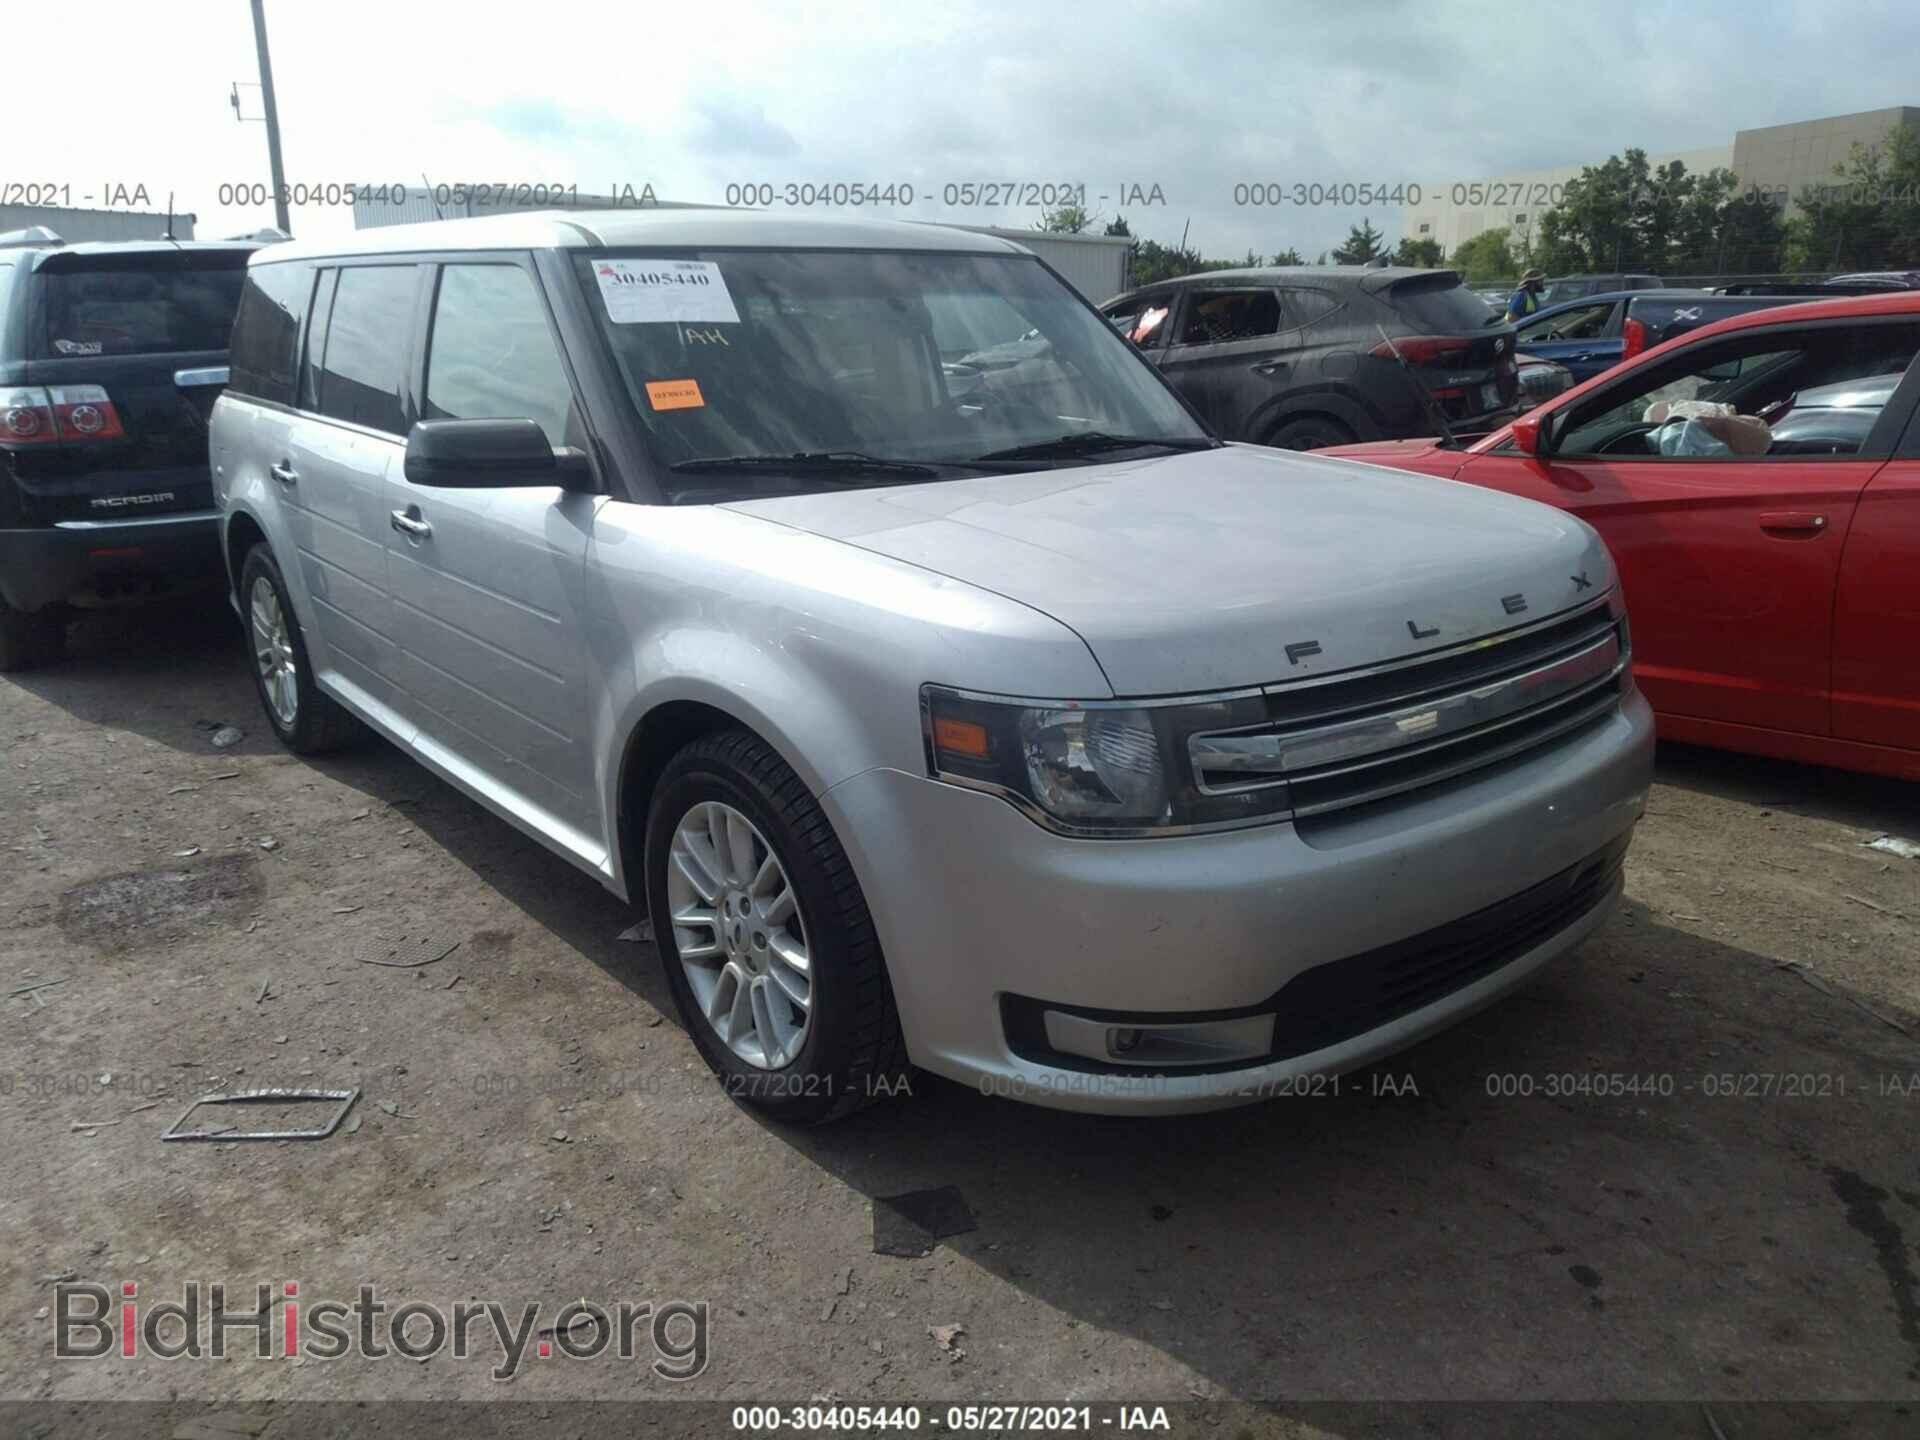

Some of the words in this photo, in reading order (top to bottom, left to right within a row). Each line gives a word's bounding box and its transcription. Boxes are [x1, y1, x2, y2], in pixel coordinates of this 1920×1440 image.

[611, 272, 710, 287] 30405440
[91, 491, 175, 508] ACADIA
[1284, 571, 1593, 666] FLEX
